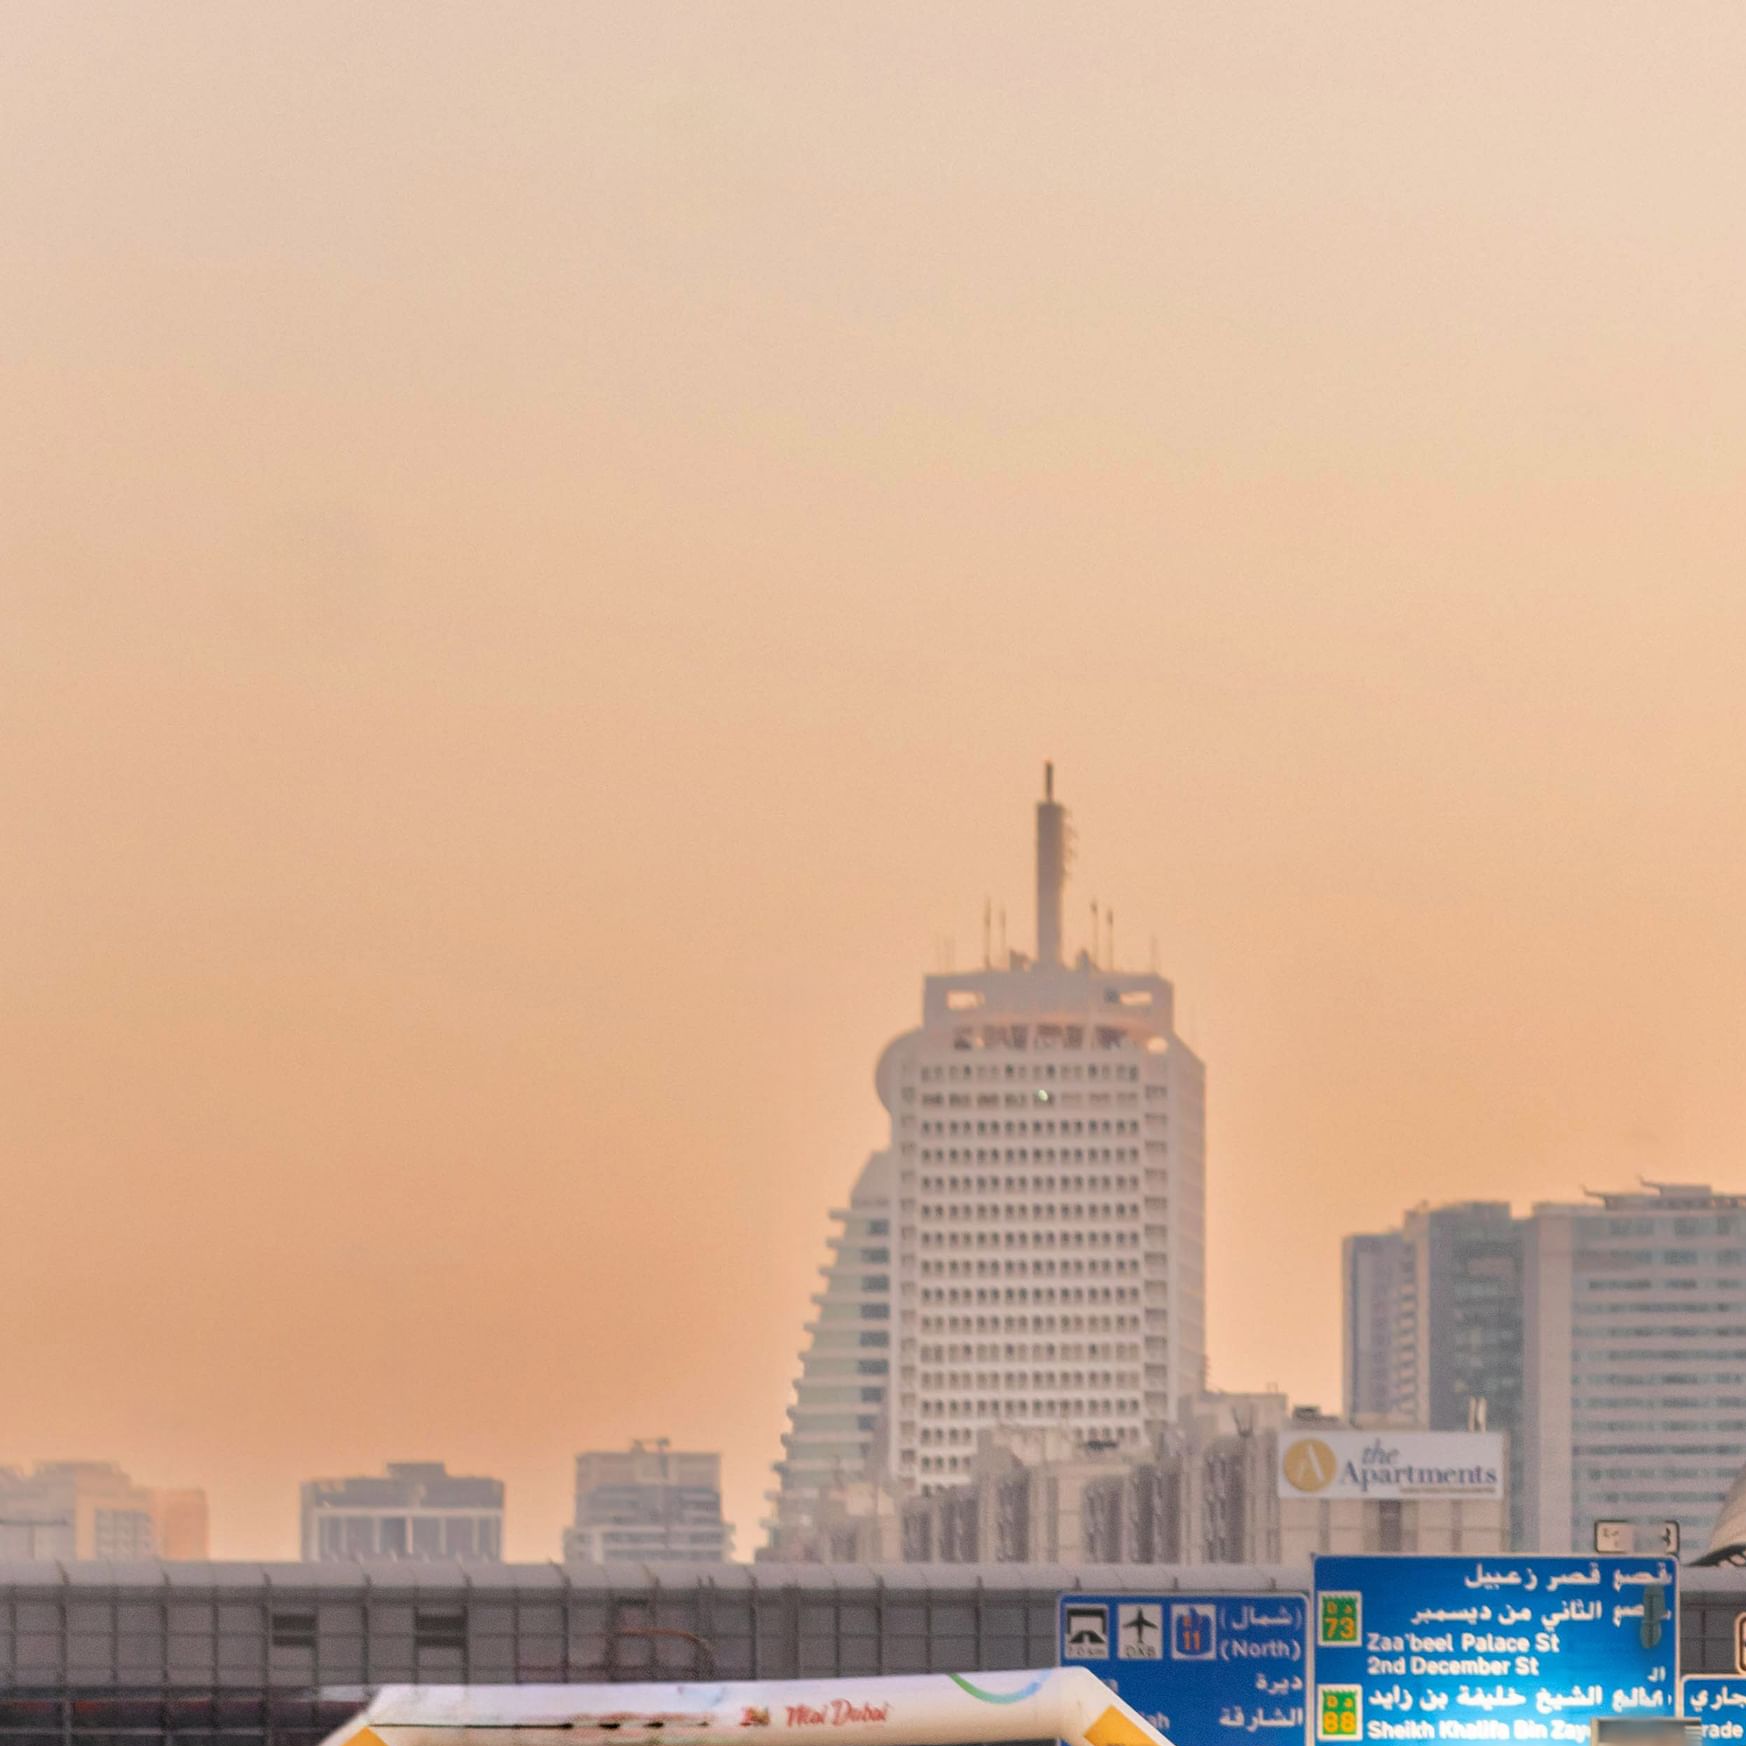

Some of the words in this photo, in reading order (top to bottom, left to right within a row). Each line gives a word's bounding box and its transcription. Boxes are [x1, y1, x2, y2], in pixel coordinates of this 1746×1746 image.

[1362, 1439, 1399, 1465] the
[1340, 1461, 1497, 1492] Apartments
[1465, 1563, 1537, 1589] زعبيل
[1411, 1604, 1491, 1625] ديسمبر
[1499, 1604, 1532, 1625] من
[1541, 1600, 1602, 1630] الثاني
[1325, 1617, 1356, 1639] 73
[1220, 1638, 1301, 1661] (North)
[1461, 1632, 1531, 1652] Palace
[1535, 1632, 1560, 1652] St
[1367, 1656, 1406, 1676] 2nd
[1411, 1656, 1510, 1676] December
[1515, 1656, 1540, 1676] St
[1255, 1672, 1303, 1695] ديرة
[1535, 1686, 1603, 1713] الشيخ
[1219, 1706, 1303, 1732] الشارقة
[1324, 1711, 1356, 1734] 88
[1700, 1720, 1744, 1739] rade
[1367, 1720, 1435, 1741] Sheikh
[1439, 1720, 1510, 1741] Khalifa
[1514, 1720, 1547, 1741] Bin
[1551, 1721, 1592, 1744] Zay
